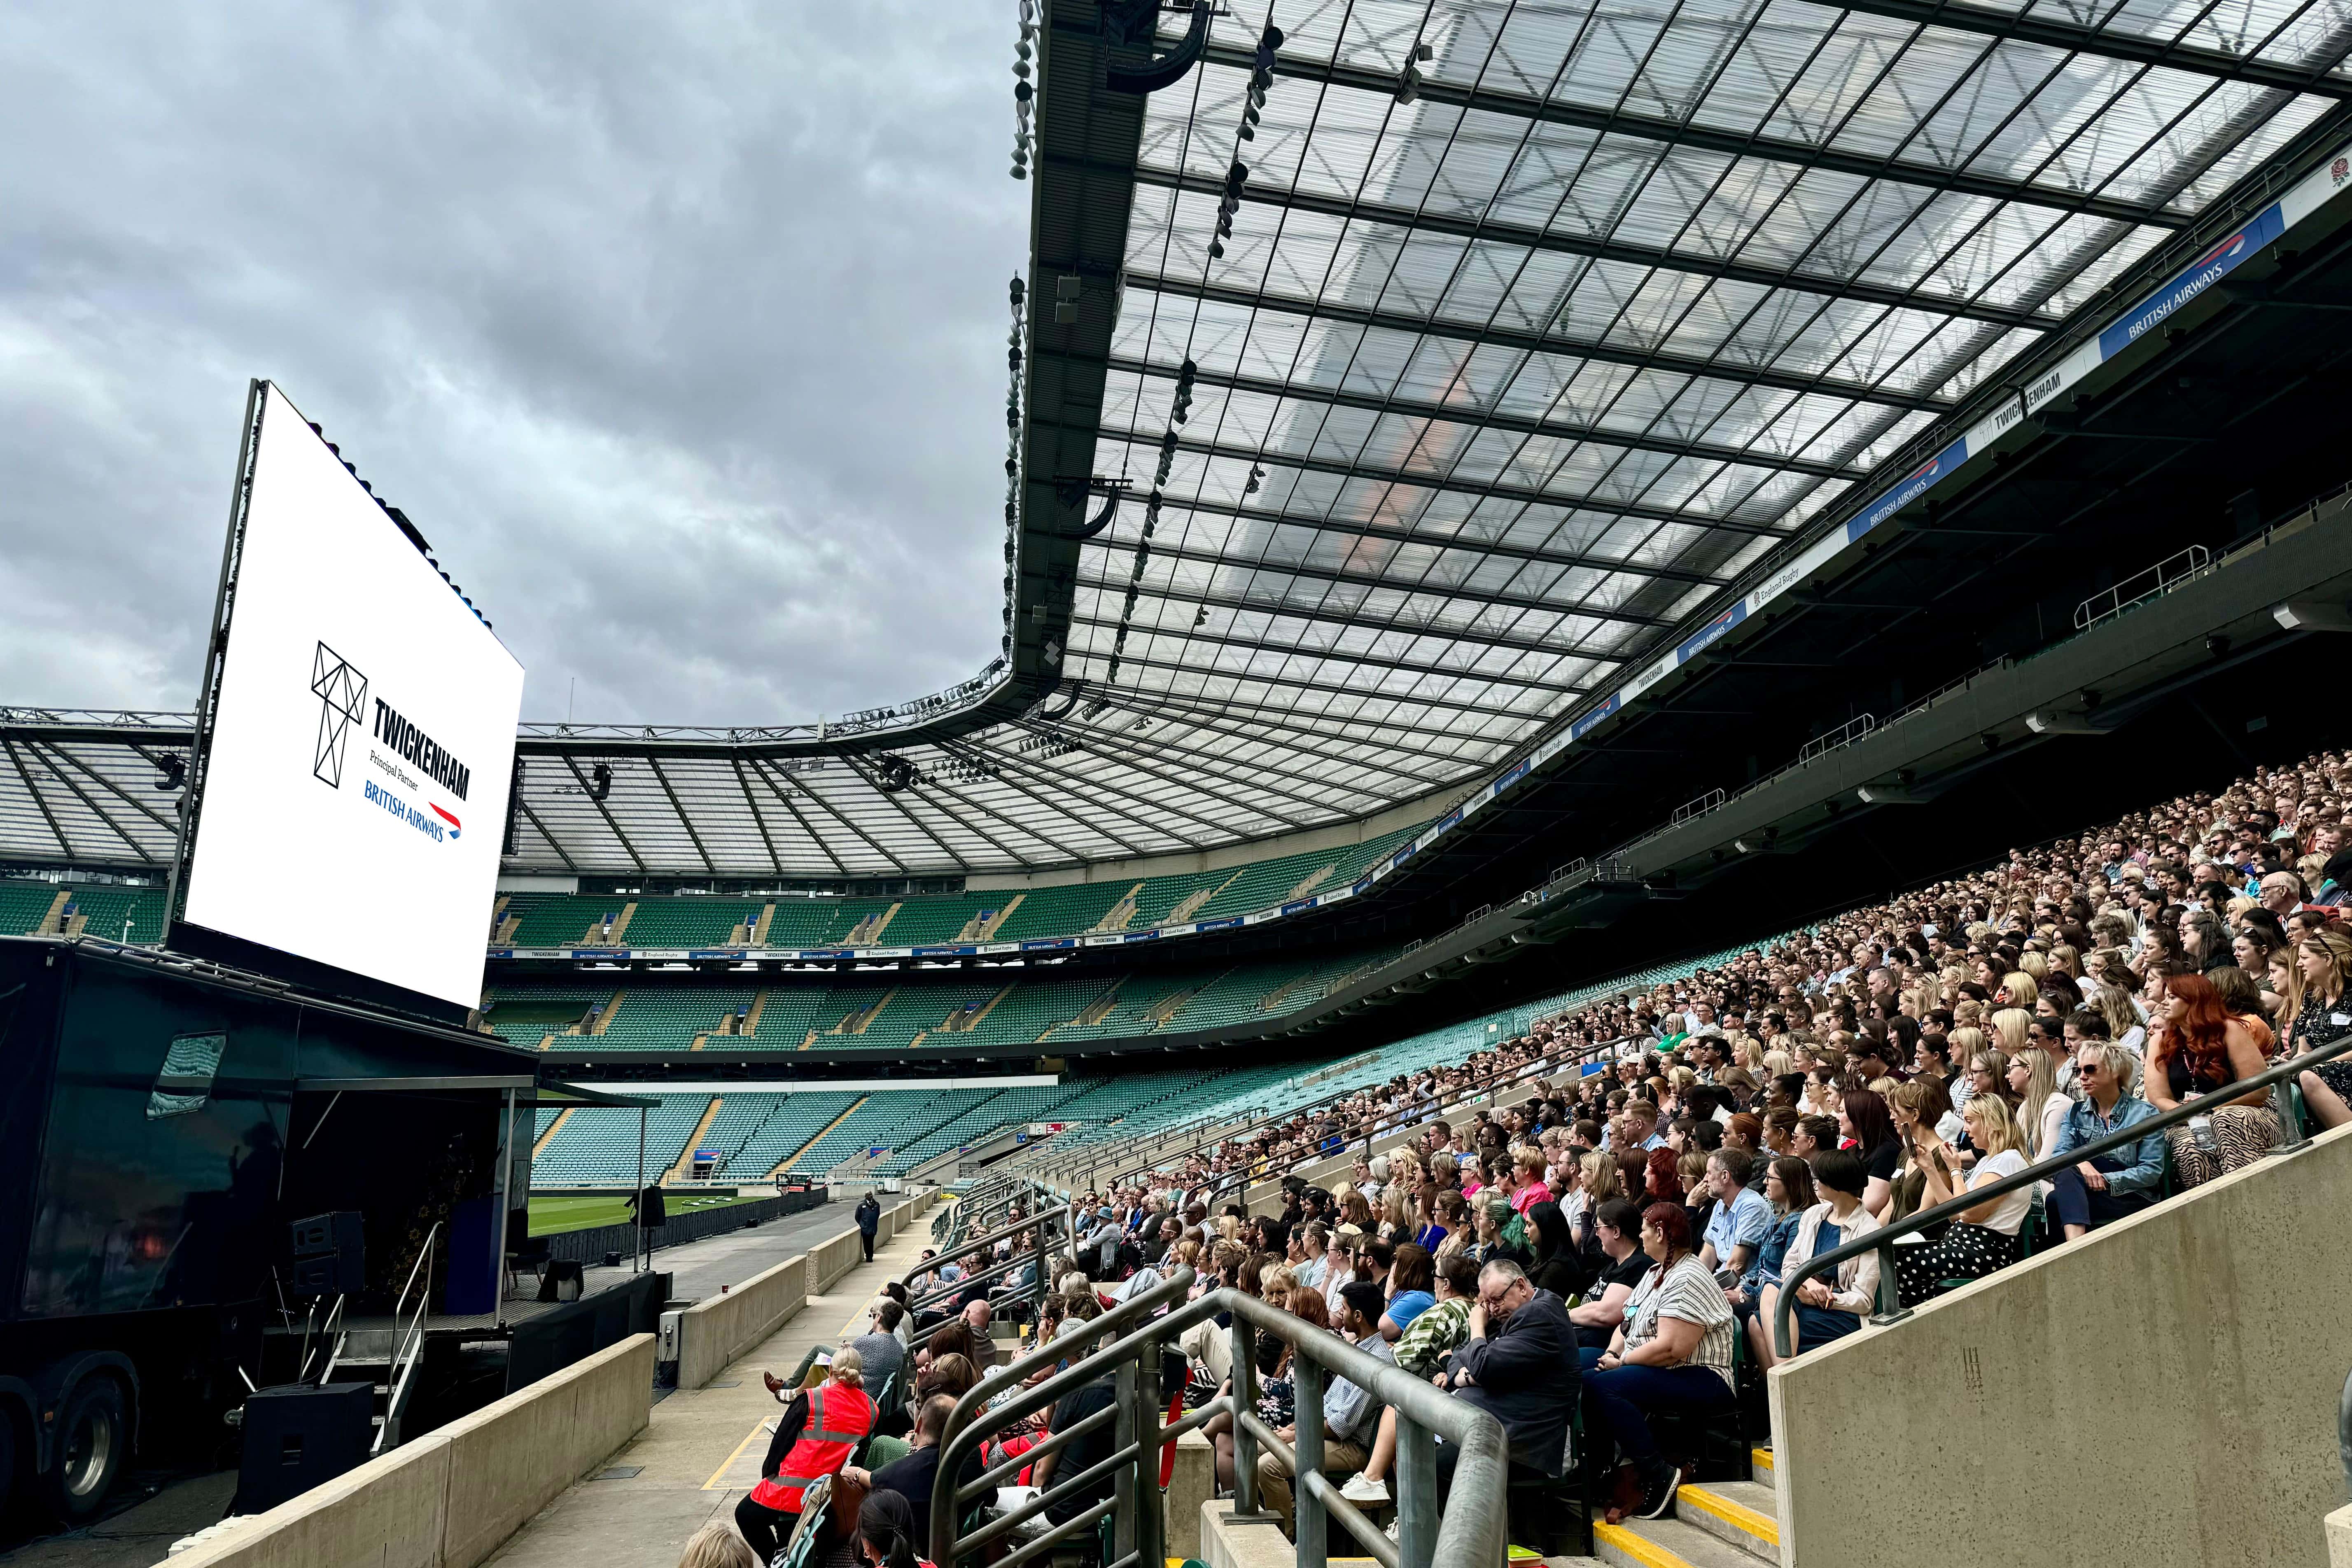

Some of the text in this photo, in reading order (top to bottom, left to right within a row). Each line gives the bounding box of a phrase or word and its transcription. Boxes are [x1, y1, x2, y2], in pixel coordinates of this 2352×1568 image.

[2128, 262, 2222, 340] BRITISH AIRWAYS
[1870, 479, 1926, 526] BRITISH AIRWAYS
[1761, 567, 1799, 600] England Rugby
[1688, 625, 1725, 656] BRITISH AIRWAYS
[1638, 663, 1663, 689] TWICKENHAM
[1579, 711, 1605, 735] BRITISH AIRWAYS
[370, 749, 418, 791] Principal Partner
[373, 696, 470, 802] TWICKENHAM
[364, 779, 443, 843] BRITISH AIRWAYS
